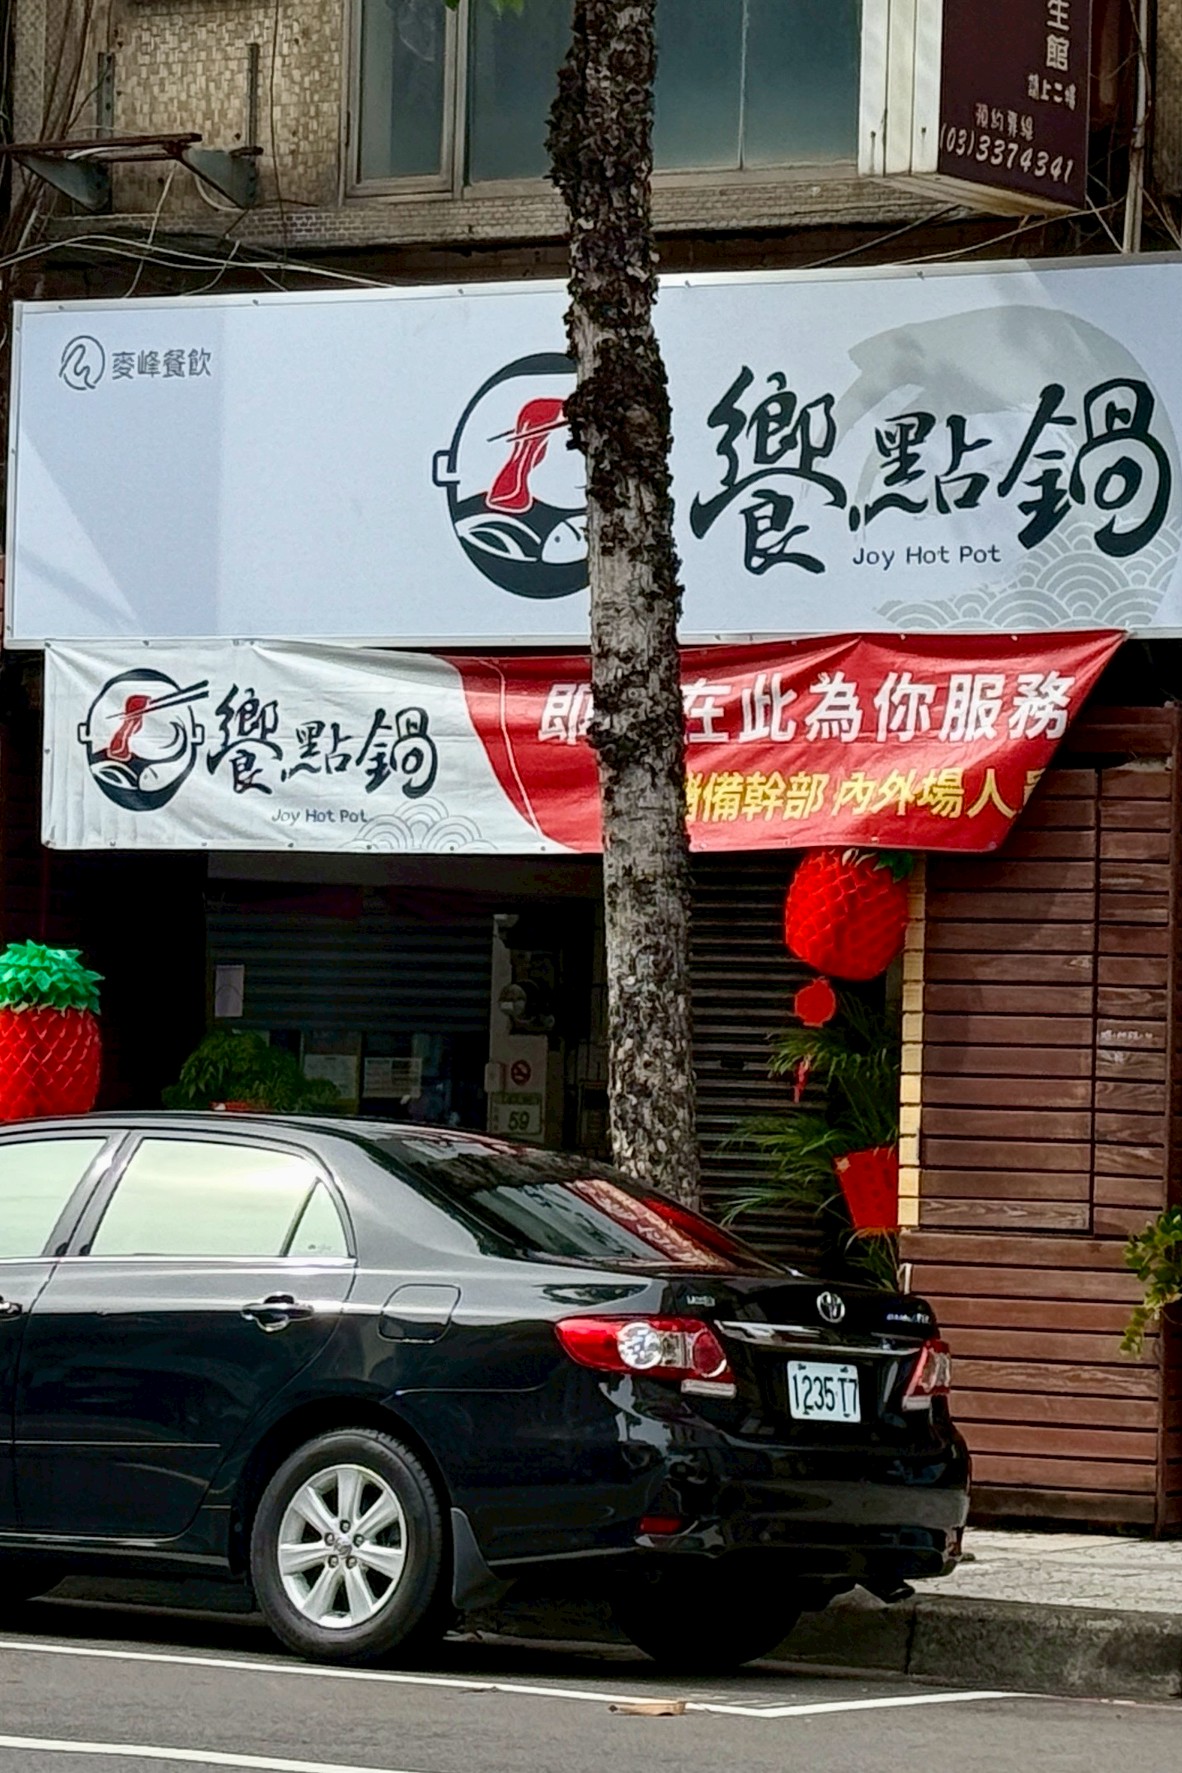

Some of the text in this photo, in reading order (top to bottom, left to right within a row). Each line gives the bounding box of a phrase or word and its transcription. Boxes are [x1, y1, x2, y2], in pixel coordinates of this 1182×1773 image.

[940, 122, 1073, 183] (03)3374341
[111, 347, 212, 380] 麥峰餐飲
[690, 365, 1172, 576] 饗點鍋
[853, 545, 1002, 571] Joy Hot Pot
[538, 671, 1077, 745] 即在此為你服務
[206, 683, 439, 799] 饗點鍋
[271, 809, 368, 824] Joy Hot Pot
